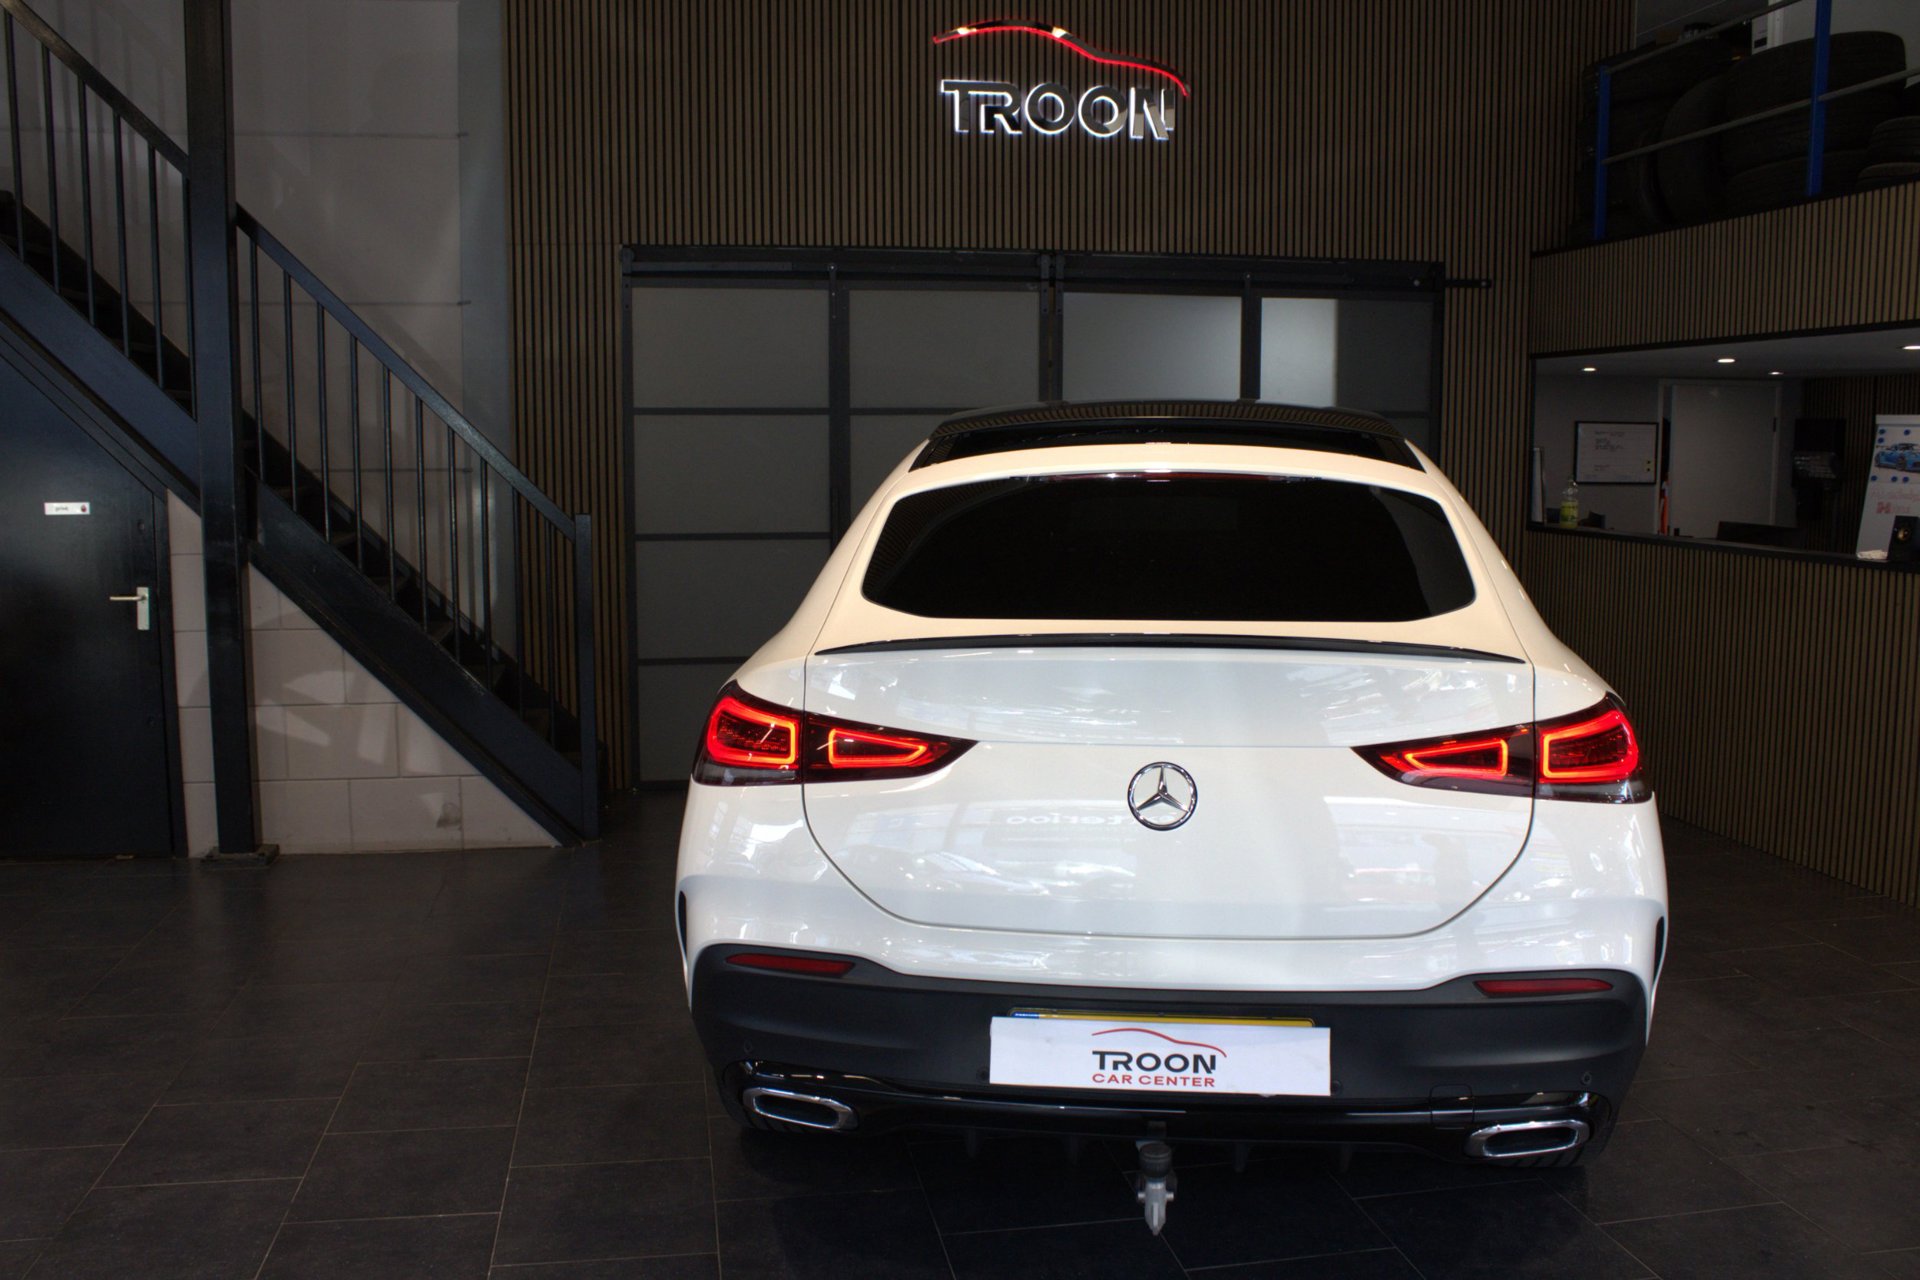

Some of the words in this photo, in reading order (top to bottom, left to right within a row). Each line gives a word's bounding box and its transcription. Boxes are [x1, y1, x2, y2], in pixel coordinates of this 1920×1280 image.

[941, 79, 1176, 141] TROON
[1092, 1050, 1216, 1074] TROON
[1092, 1073, 1132, 1084] CAR
[1138, 1075, 1215, 1087] CENTER
